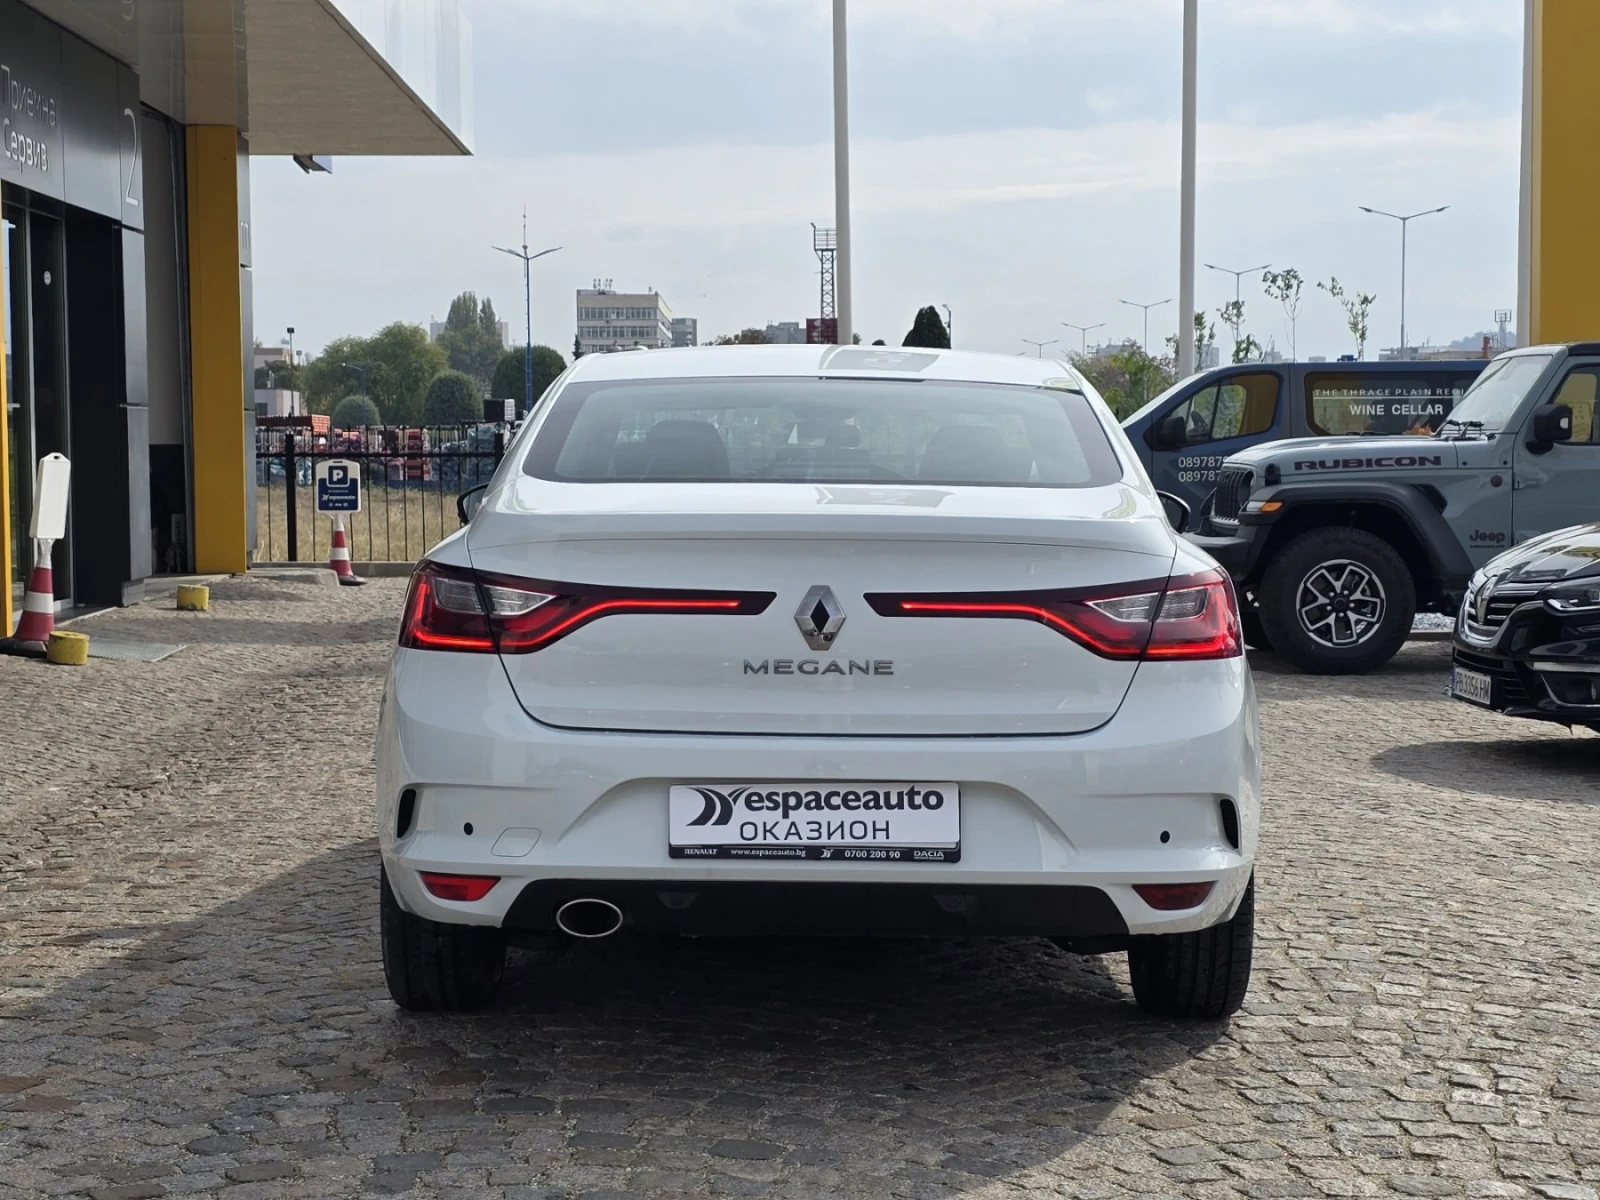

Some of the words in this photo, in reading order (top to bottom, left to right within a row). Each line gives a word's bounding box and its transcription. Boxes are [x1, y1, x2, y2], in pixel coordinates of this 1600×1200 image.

[123, 107, 139, 207] 2
[1343, 388, 1391, 396] THRACE
[1395, 388, 1432, 396] PLAIN
[1350, 404, 1385, 416] WINE
[1391, 404, 1444, 415] CELLAR
[1294, 455, 1442, 471] RUBICON
[332, 469, 344, 482] P
[1469, 529, 1506, 544] Jeep
[743, 658, 895, 676] MEGANE
[744, 785, 944, 819] espaceauto
[739, 820, 891, 841] ОКАЗИОН
[730, 849, 806, 858] www.espaceauto.bg
[844, 850, 867, 858] 0700
[869, 850, 887, 858] 200
[888, 850, 901, 859] 90
